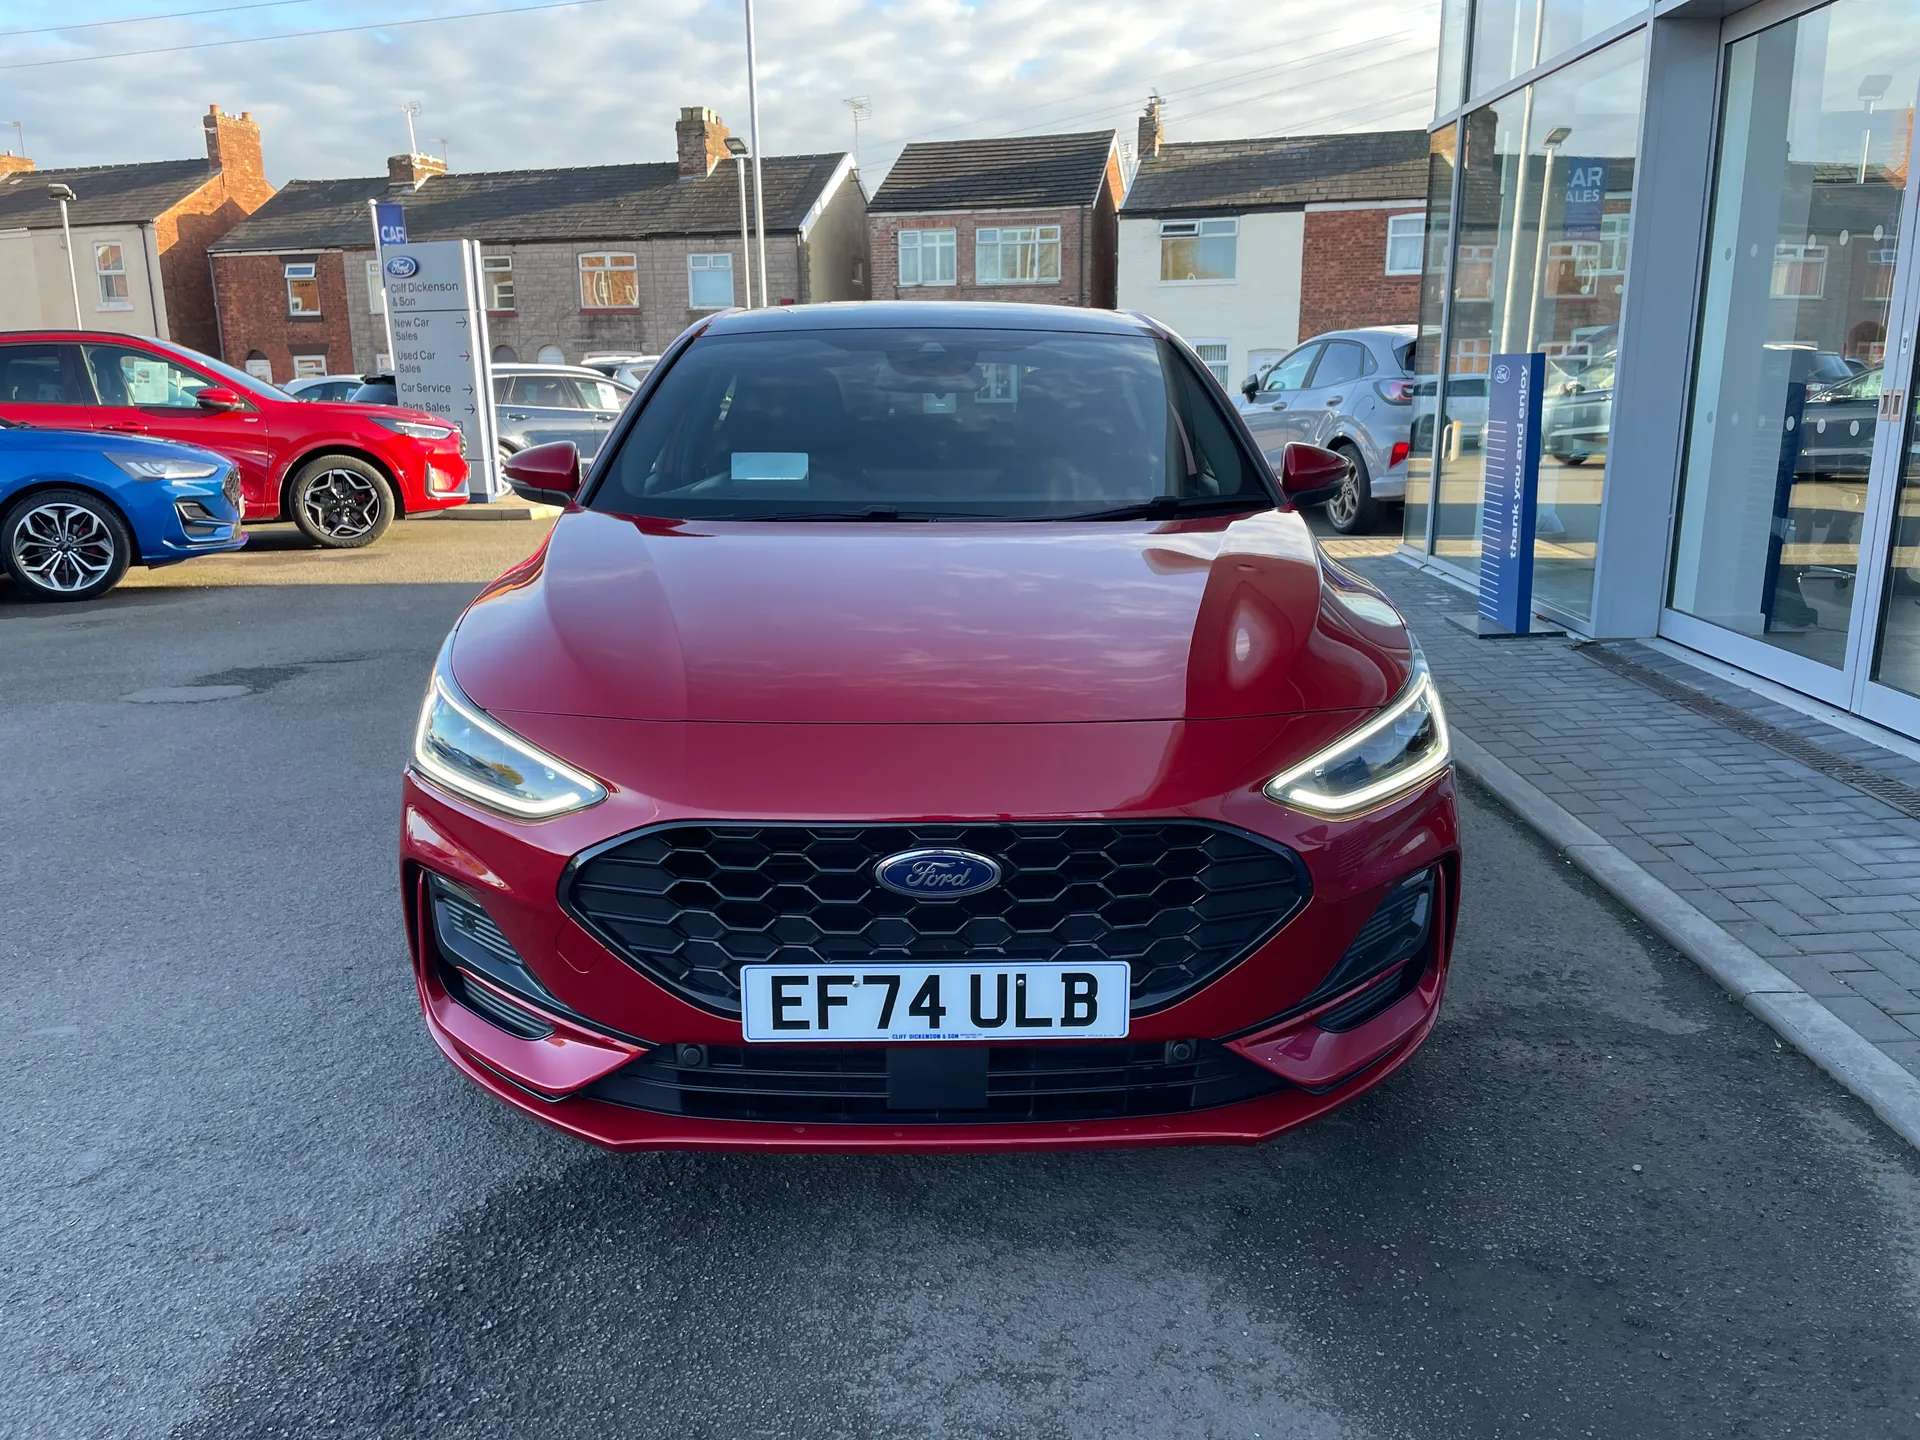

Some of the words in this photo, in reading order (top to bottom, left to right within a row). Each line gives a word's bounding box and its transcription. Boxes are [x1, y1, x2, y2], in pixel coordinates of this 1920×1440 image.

[1568, 167, 1603, 187] AR
[1566, 188, 1600, 202] ALES
[381, 225, 405, 242] CAR
[391, 283, 406, 294] Cliff
[408, 282, 459, 293] Dickenson
[400, 296, 416, 306] Son
[394, 318, 412, 328] New
[413, 317, 430, 328] Car
[396, 331, 418, 341] Sales
[397, 350, 418, 361] Used
[419, 350, 436, 361] Car
[399, 363, 422, 374] Sales
[401, 383, 416, 393] Car
[416, 382, 452, 393] Service
[1518, 365, 1528, 419] enjoy
[425, 402, 451, 412] Sales
[1516, 423, 1524, 460] and
[1513, 464, 1521, 500] you
[1509, 503, 1519, 559] thank
[906, 861, 972, 887] Ford
[771, 974, 946, 1030] EF74
[971, 972, 1099, 1028] ULB
